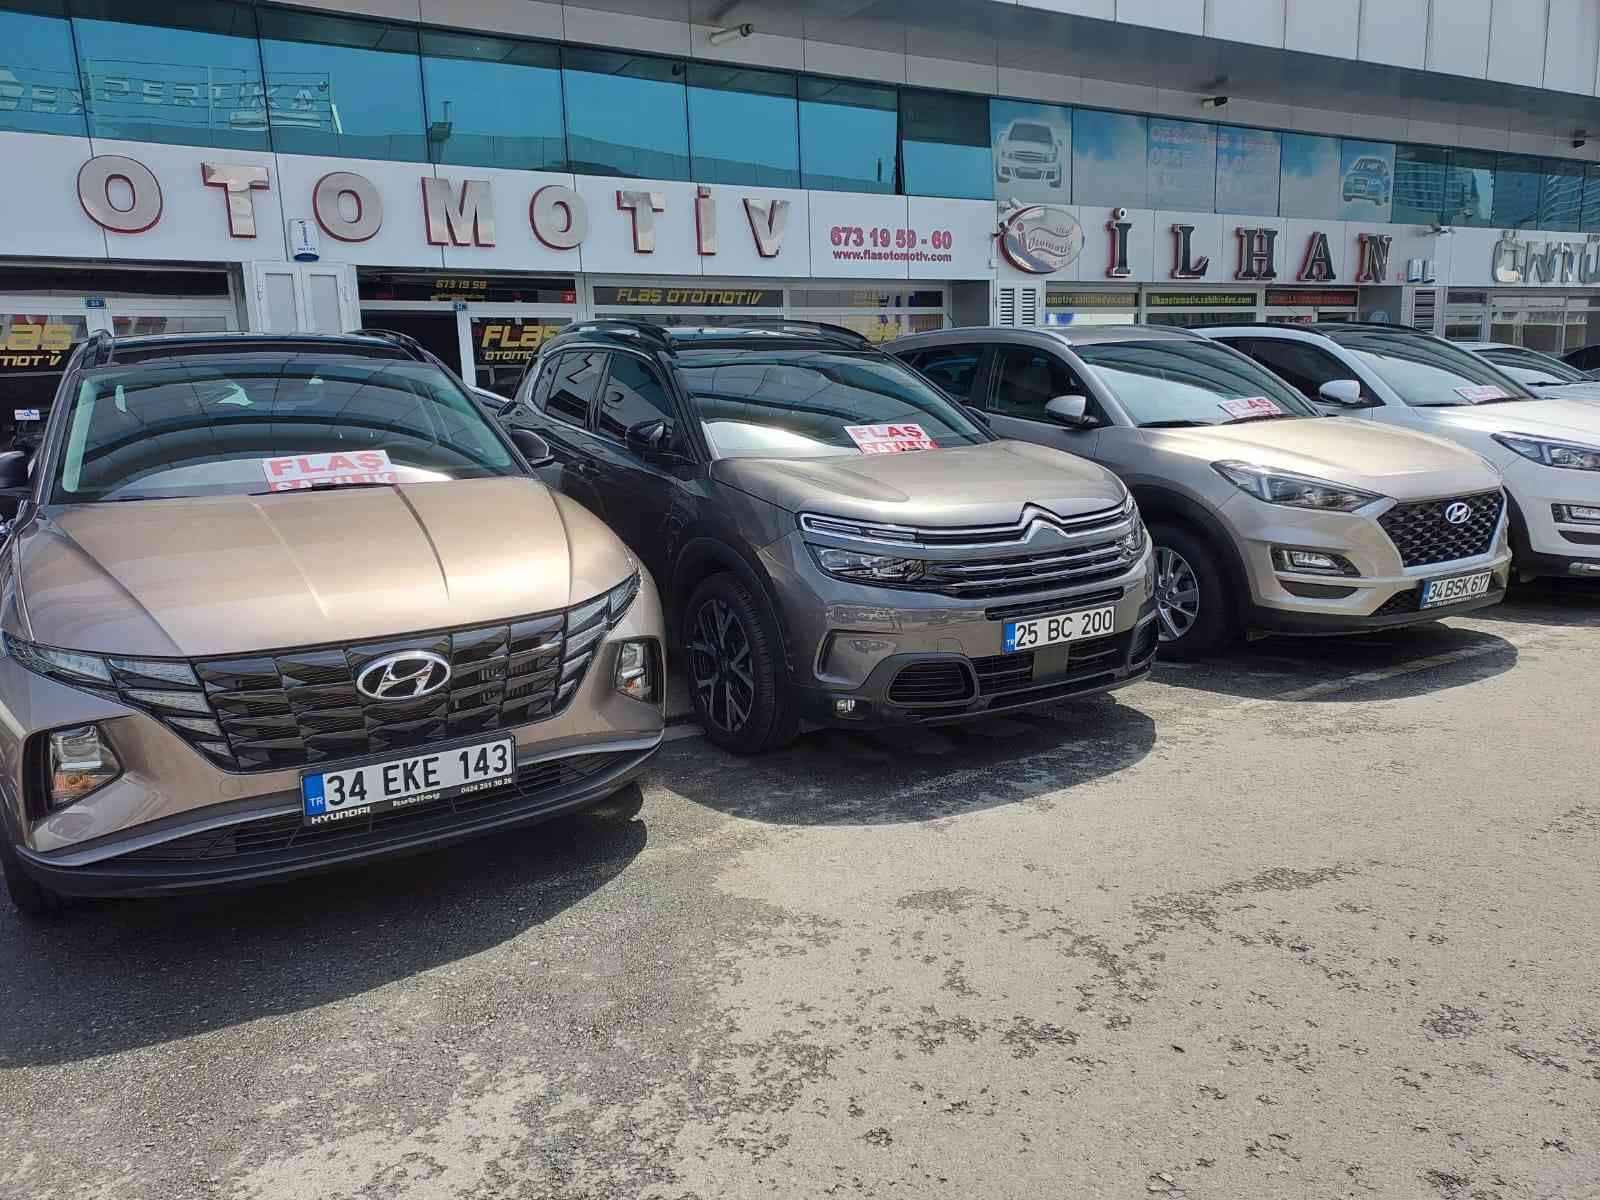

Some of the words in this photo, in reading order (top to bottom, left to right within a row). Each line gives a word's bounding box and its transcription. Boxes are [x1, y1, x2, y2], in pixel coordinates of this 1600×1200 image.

[831, 226, 864, 247] 673
[870, 228, 891, 247] 19
[896, 229, 917, 248] 59
[932, 230, 952, 249] 60
[833, 250, 952, 262] www.flasotomotiv.com
[1429, 582, 1443, 600] 34
[1444, 577, 1470, 598] BSK
[1015, 622, 1038, 647] 25
[1047, 617, 1073, 641] BC
[1080, 609, 1113, 635] 200
[310, 796, 324, 808] TR
[326, 771, 368, 806] 34
[383, 756, 441, 796] EKE
[458, 744, 508, 780] 143
[311, 805, 371, 825] HYUNDAI
